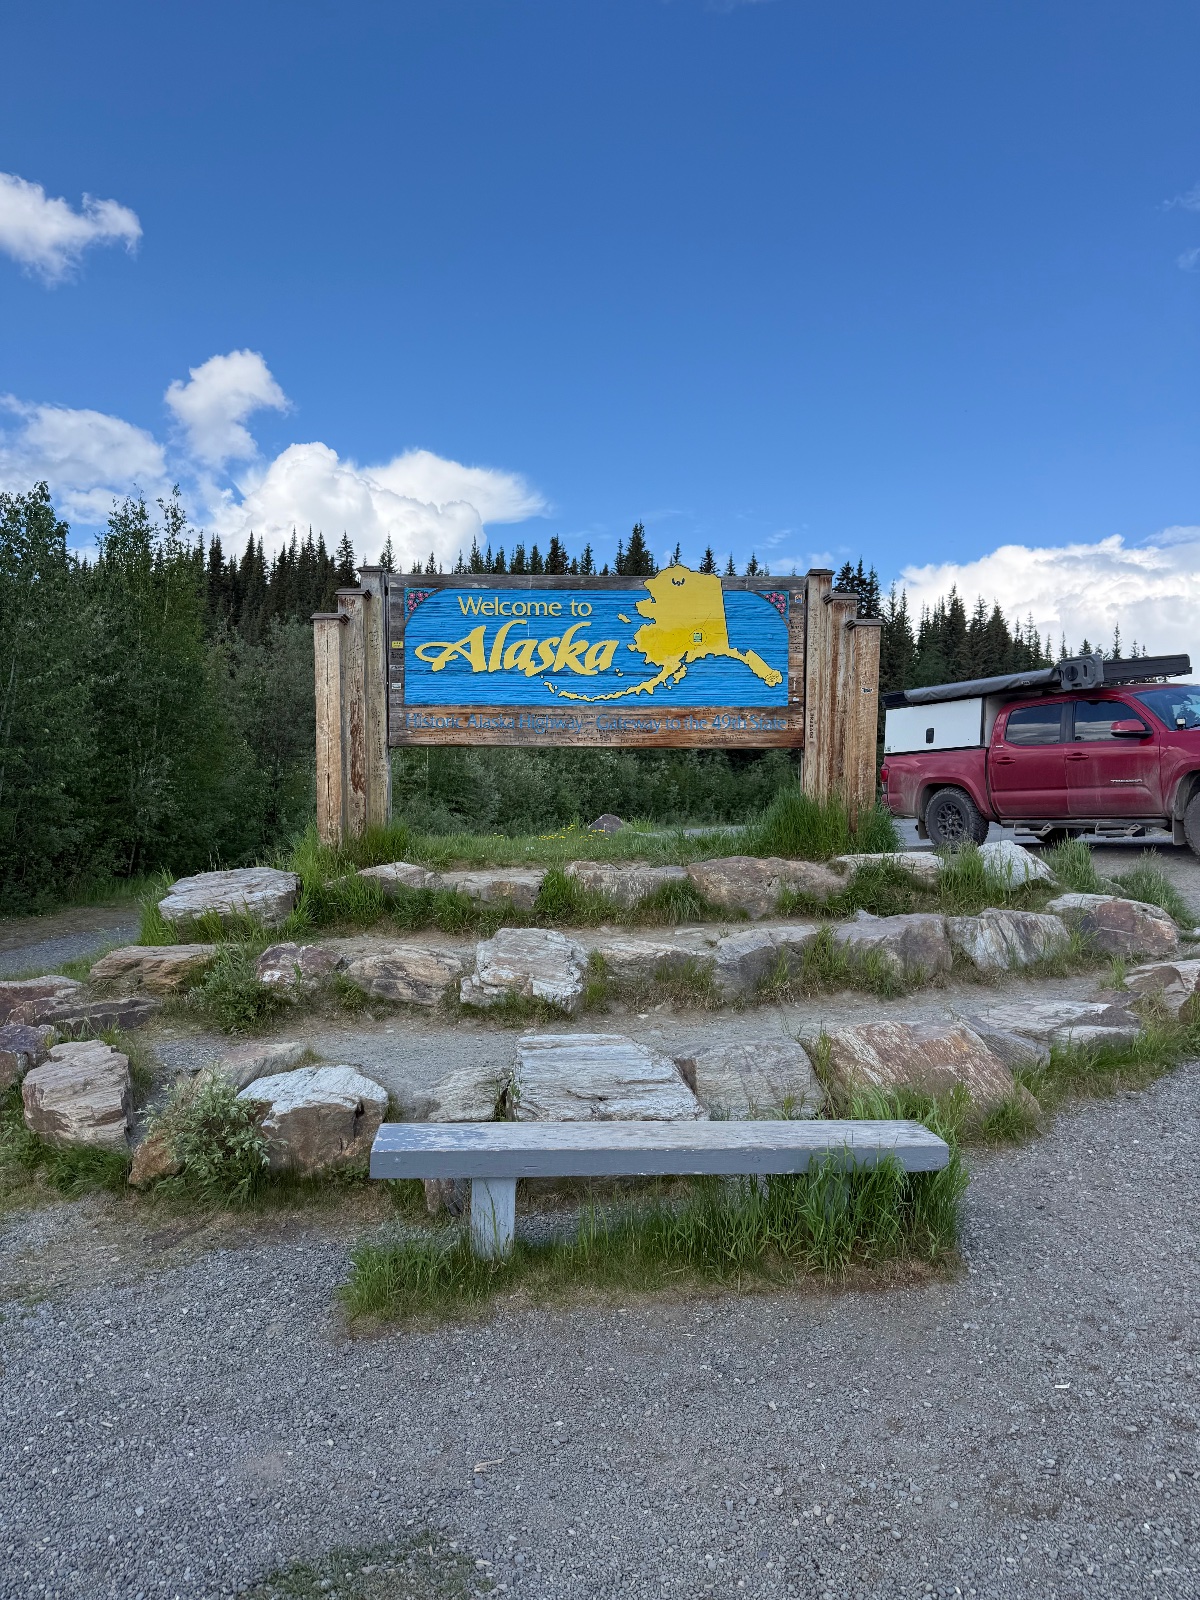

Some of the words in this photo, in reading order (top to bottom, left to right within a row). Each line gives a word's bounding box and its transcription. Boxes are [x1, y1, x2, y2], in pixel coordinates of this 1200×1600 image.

[457, 596, 562, 617] Welcome
[571, 599, 593, 617] to
[415, 619, 619, 677] Alaska
[405, 712, 463, 729] Historic
[466, 713, 515, 729] Alaska
[519, 713, 583, 734] Highway
[596, 713, 661, 734] Gateway
[665, 715, 681, 730] to
[684, 714, 709, 730] the
[711, 713, 747, 731] 49th
[750, 713, 787, 731] State
